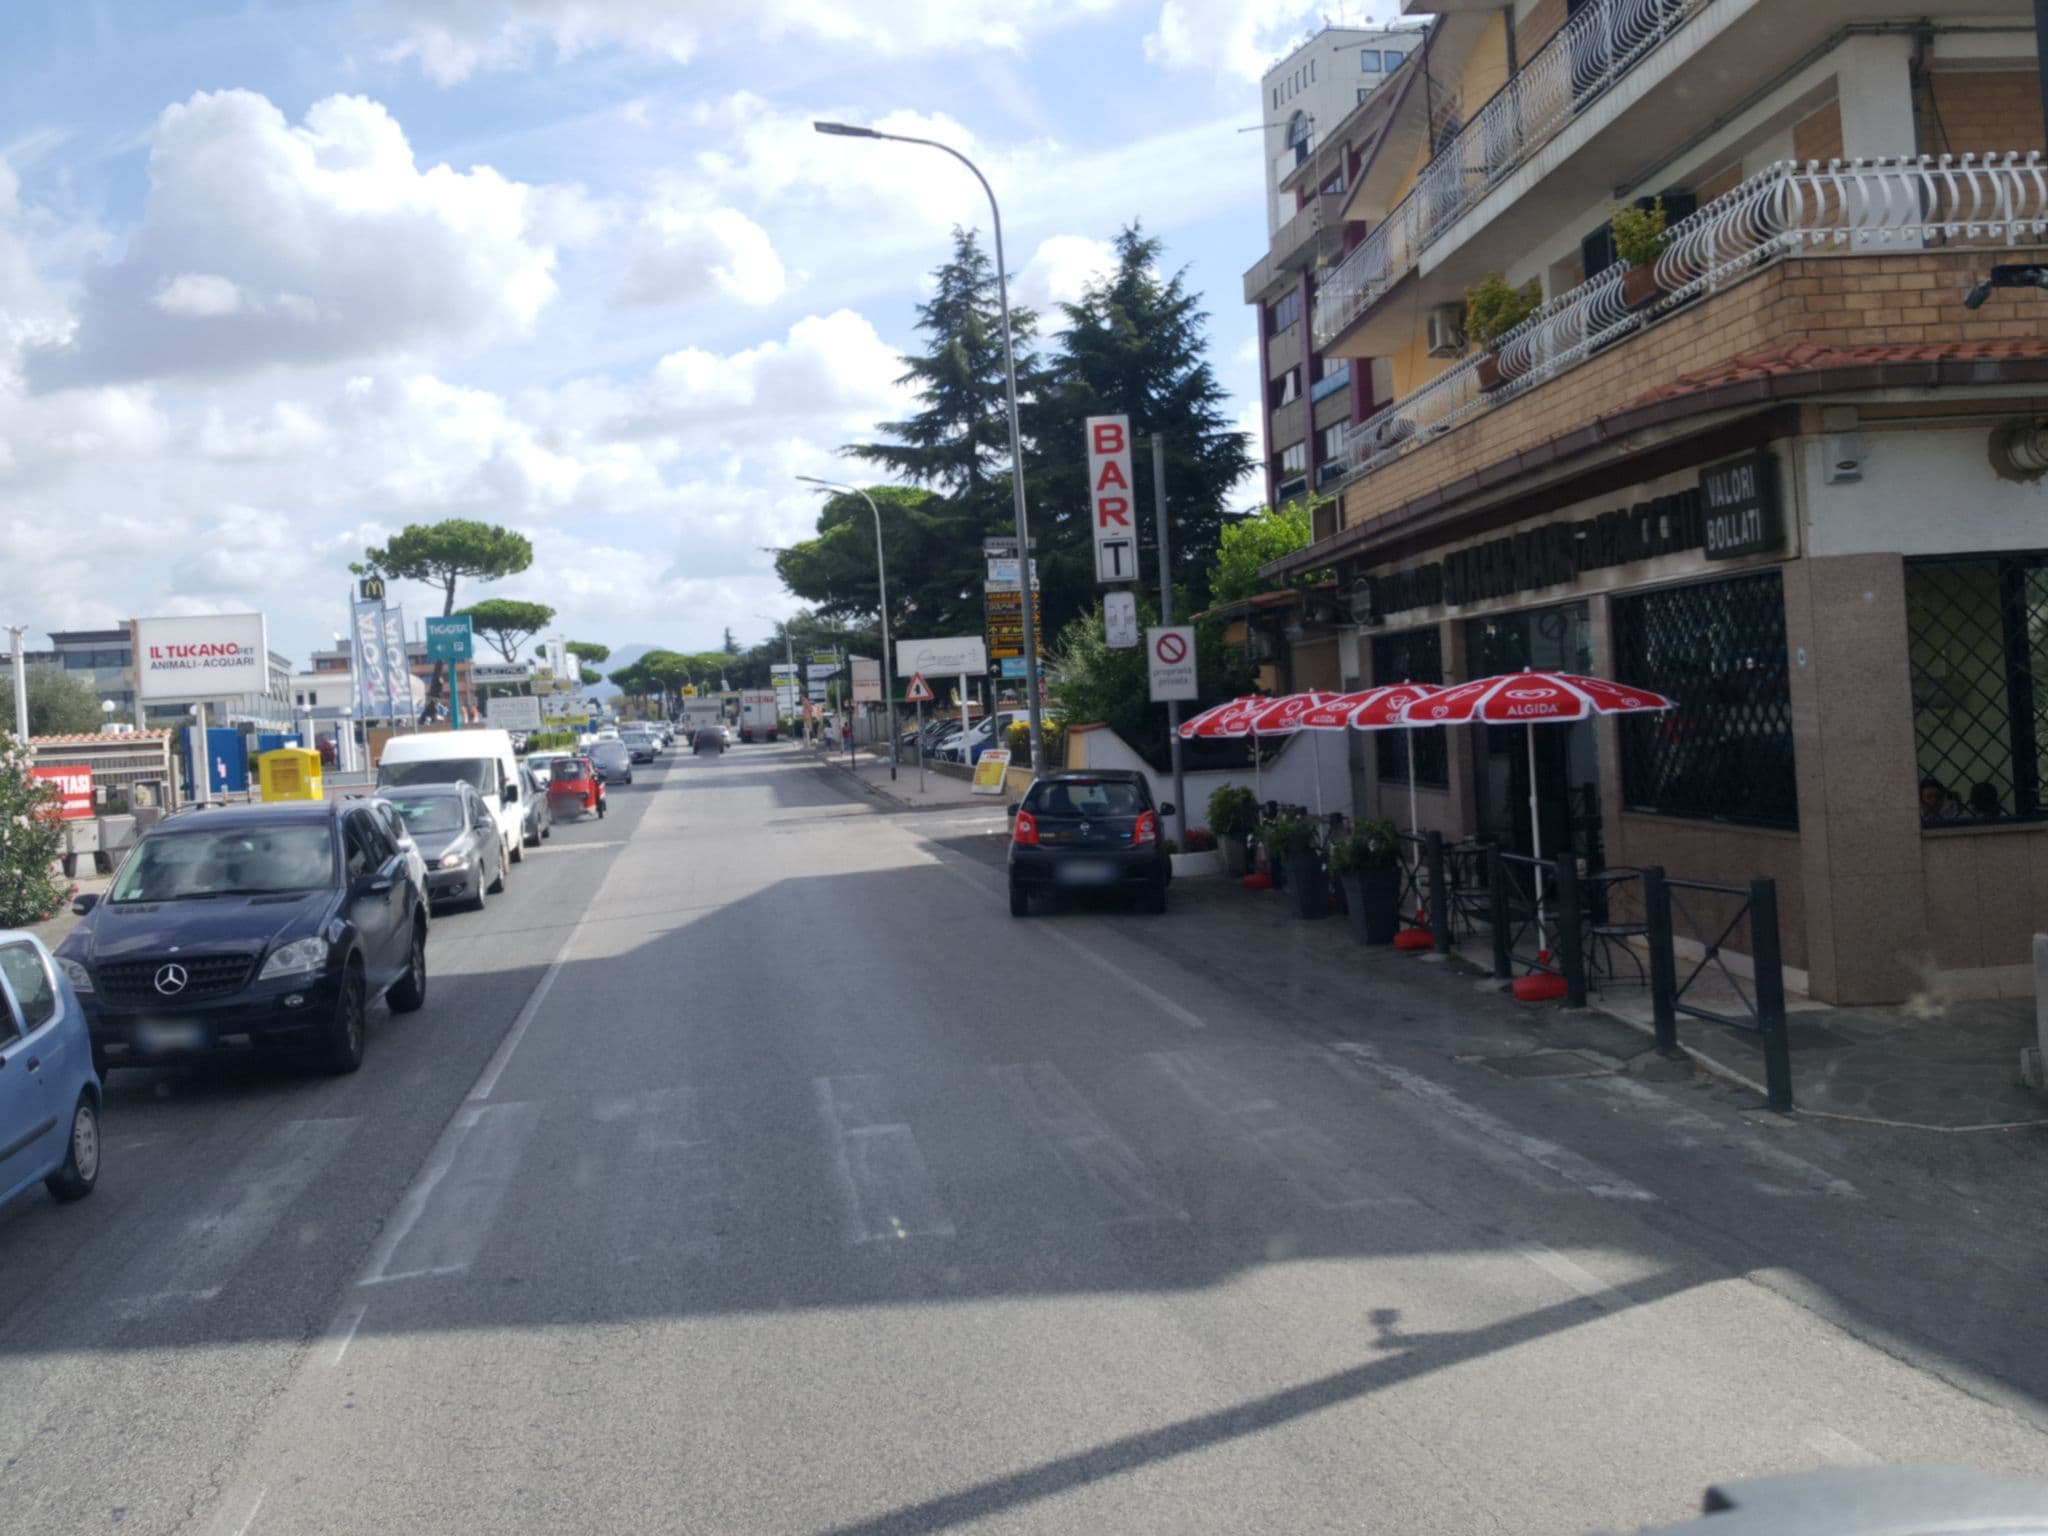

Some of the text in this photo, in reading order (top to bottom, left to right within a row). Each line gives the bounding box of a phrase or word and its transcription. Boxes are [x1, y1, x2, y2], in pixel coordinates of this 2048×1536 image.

[1093, 423, 1131, 529] BAR
[1706, 464, 1756, 508] VALORI
[1706, 507, 1761, 552] BOLLATI
[1103, 540, 1129, 577] T
[150, 646, 163, 659] IL
[165, 642, 239, 659] TUCANO
[150, 660, 197, 671] ANIMALI
[1507, 703, 1558, 716] ALGIDA
